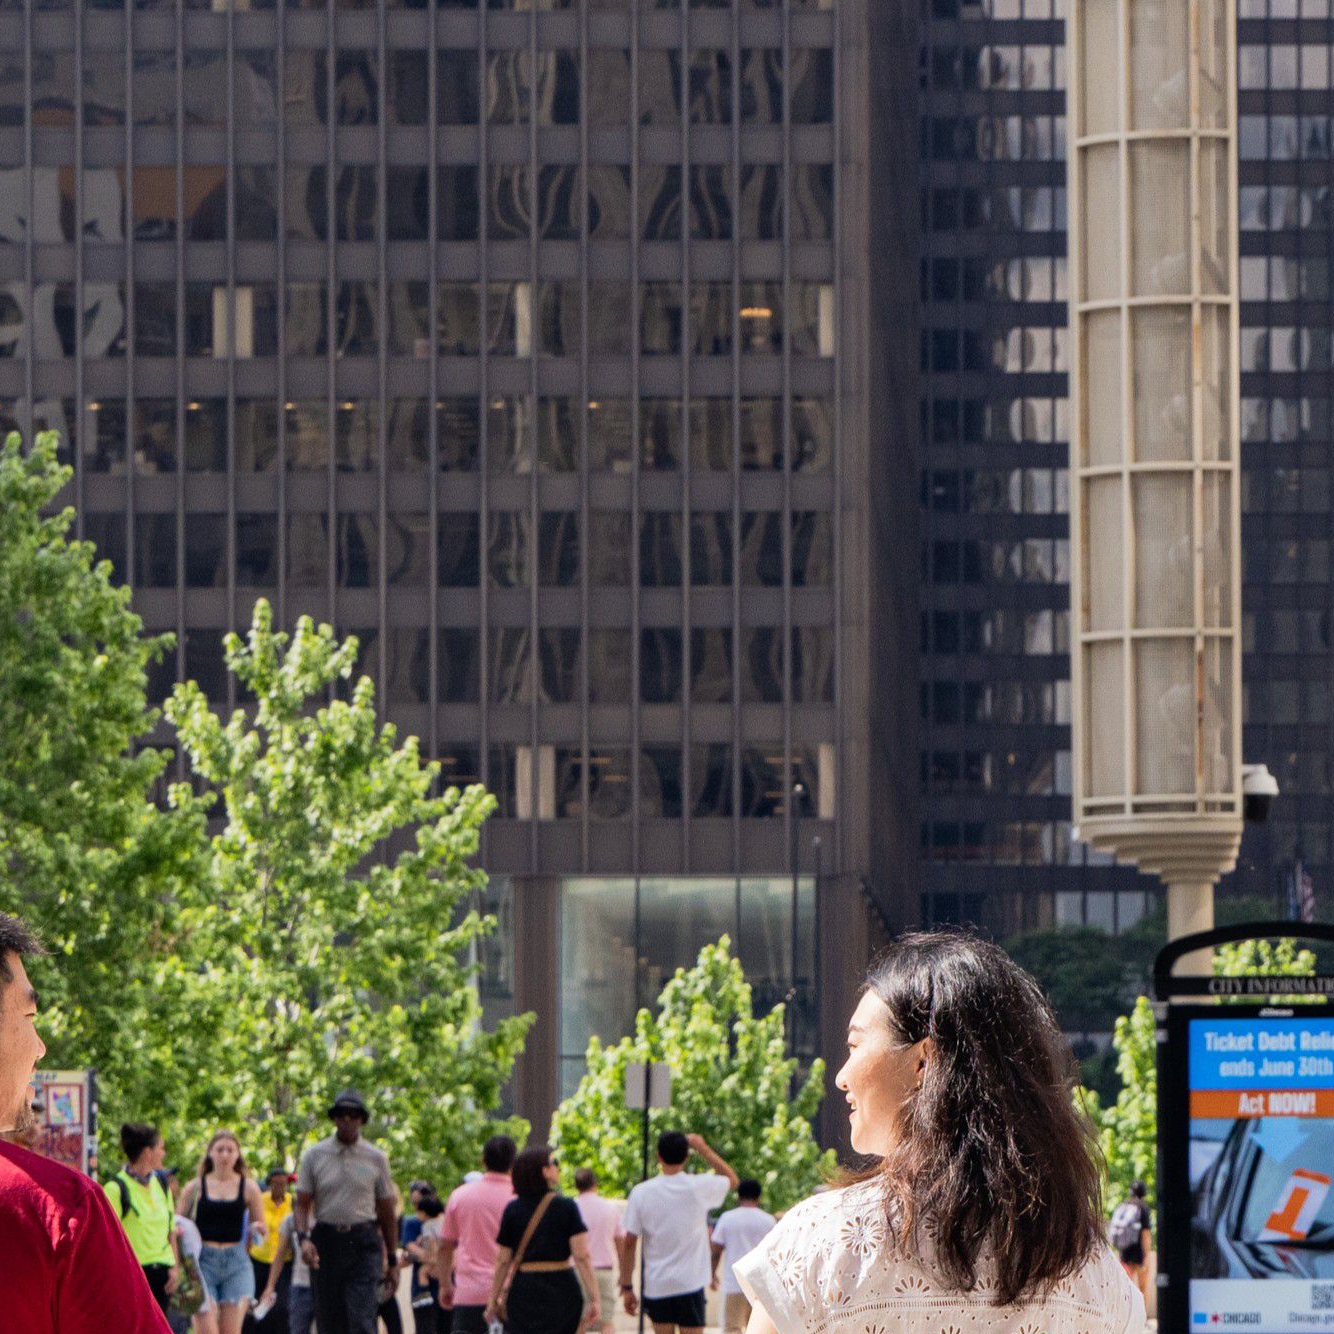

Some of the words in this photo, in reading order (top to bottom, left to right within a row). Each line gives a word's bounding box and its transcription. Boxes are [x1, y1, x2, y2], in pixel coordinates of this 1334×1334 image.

[1209, 979, 1242, 993] CITY
[1204, 1031, 1254, 1051] Ticket
[1258, 1031, 1296, 1051] Debt
[1219, 1057, 1255, 1077] ends
[1258, 1057, 1295, 1077] June
[1298, 1056, 1334, 1076] 30th
[1238, 1092, 1265, 1114] Act
[1269, 1092, 1316, 1113] NOW!
[1223, 1312, 1261, 1324] CHICAGO
